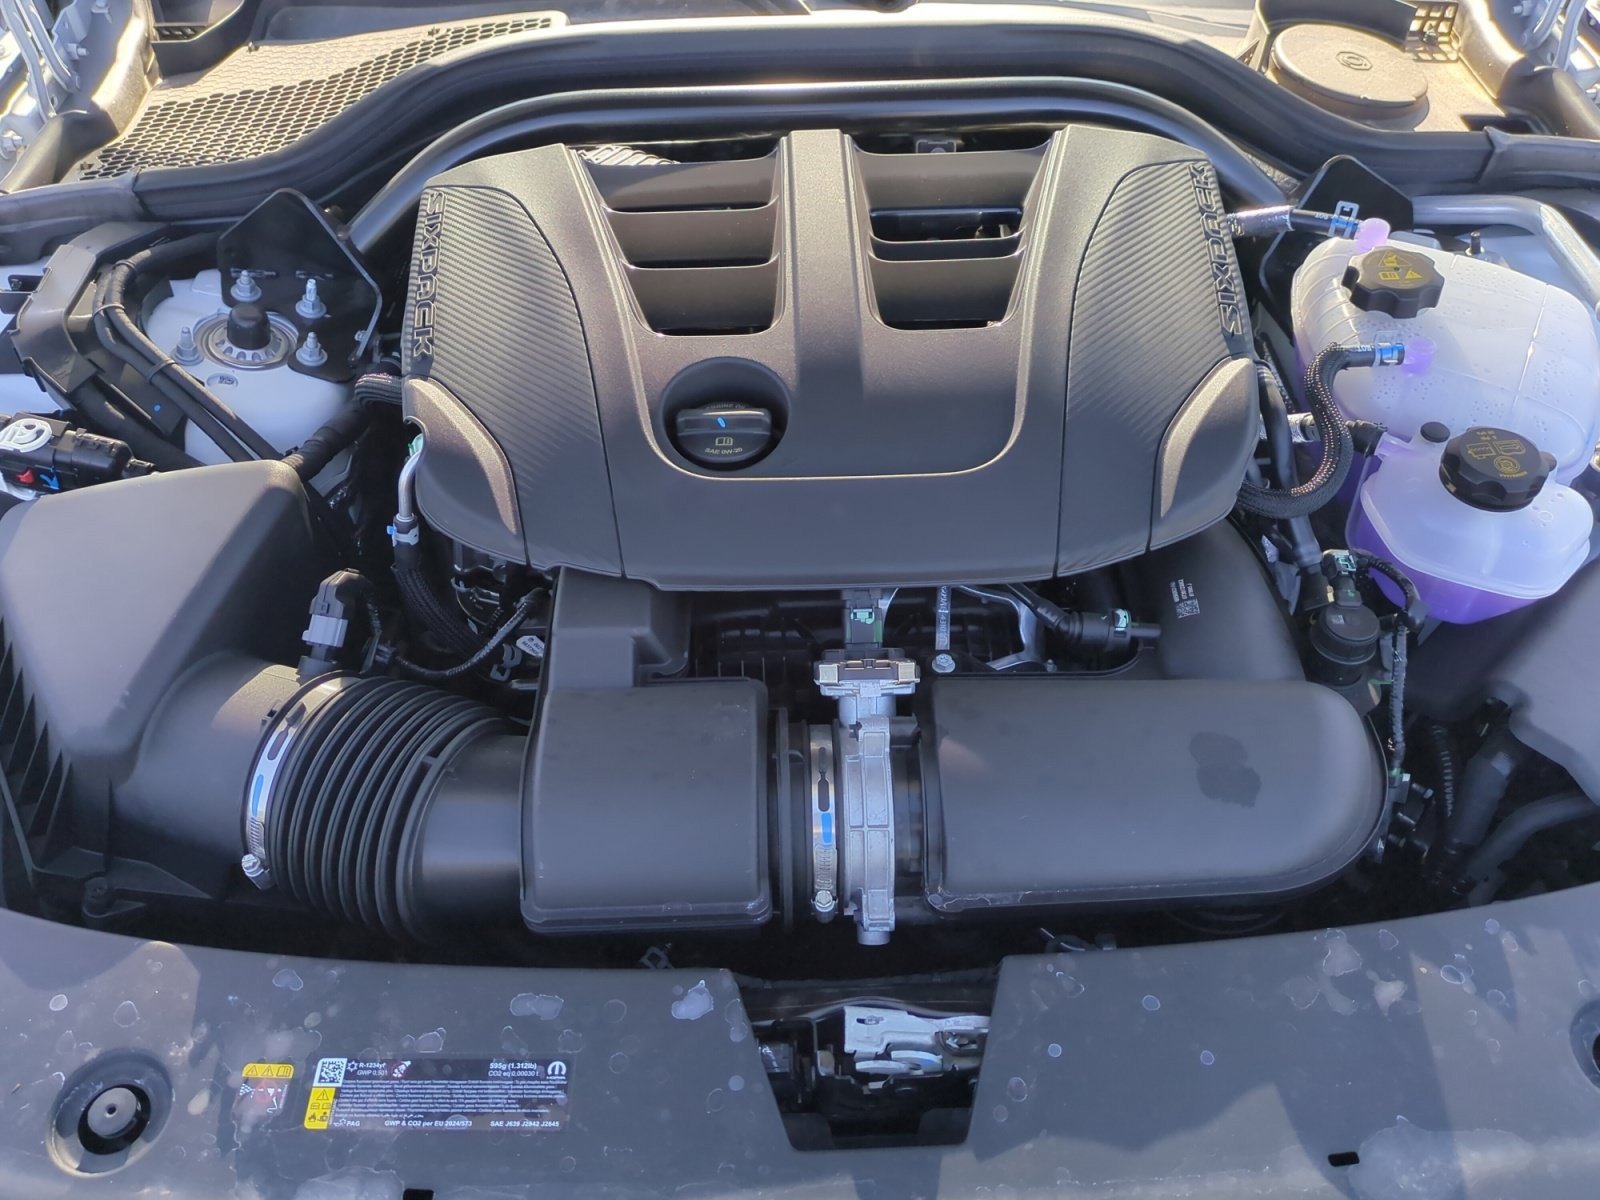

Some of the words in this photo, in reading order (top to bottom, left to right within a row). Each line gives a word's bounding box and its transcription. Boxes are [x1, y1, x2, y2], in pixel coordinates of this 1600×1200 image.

[1187, 164, 1242, 335] SIXPACK
[412, 190, 446, 358] SIXPACK
[704, 447, 720, 455] SAE
[358, 1062, 387, 1070] R-1234yf
[489, 1062, 507, 1071] 595g
